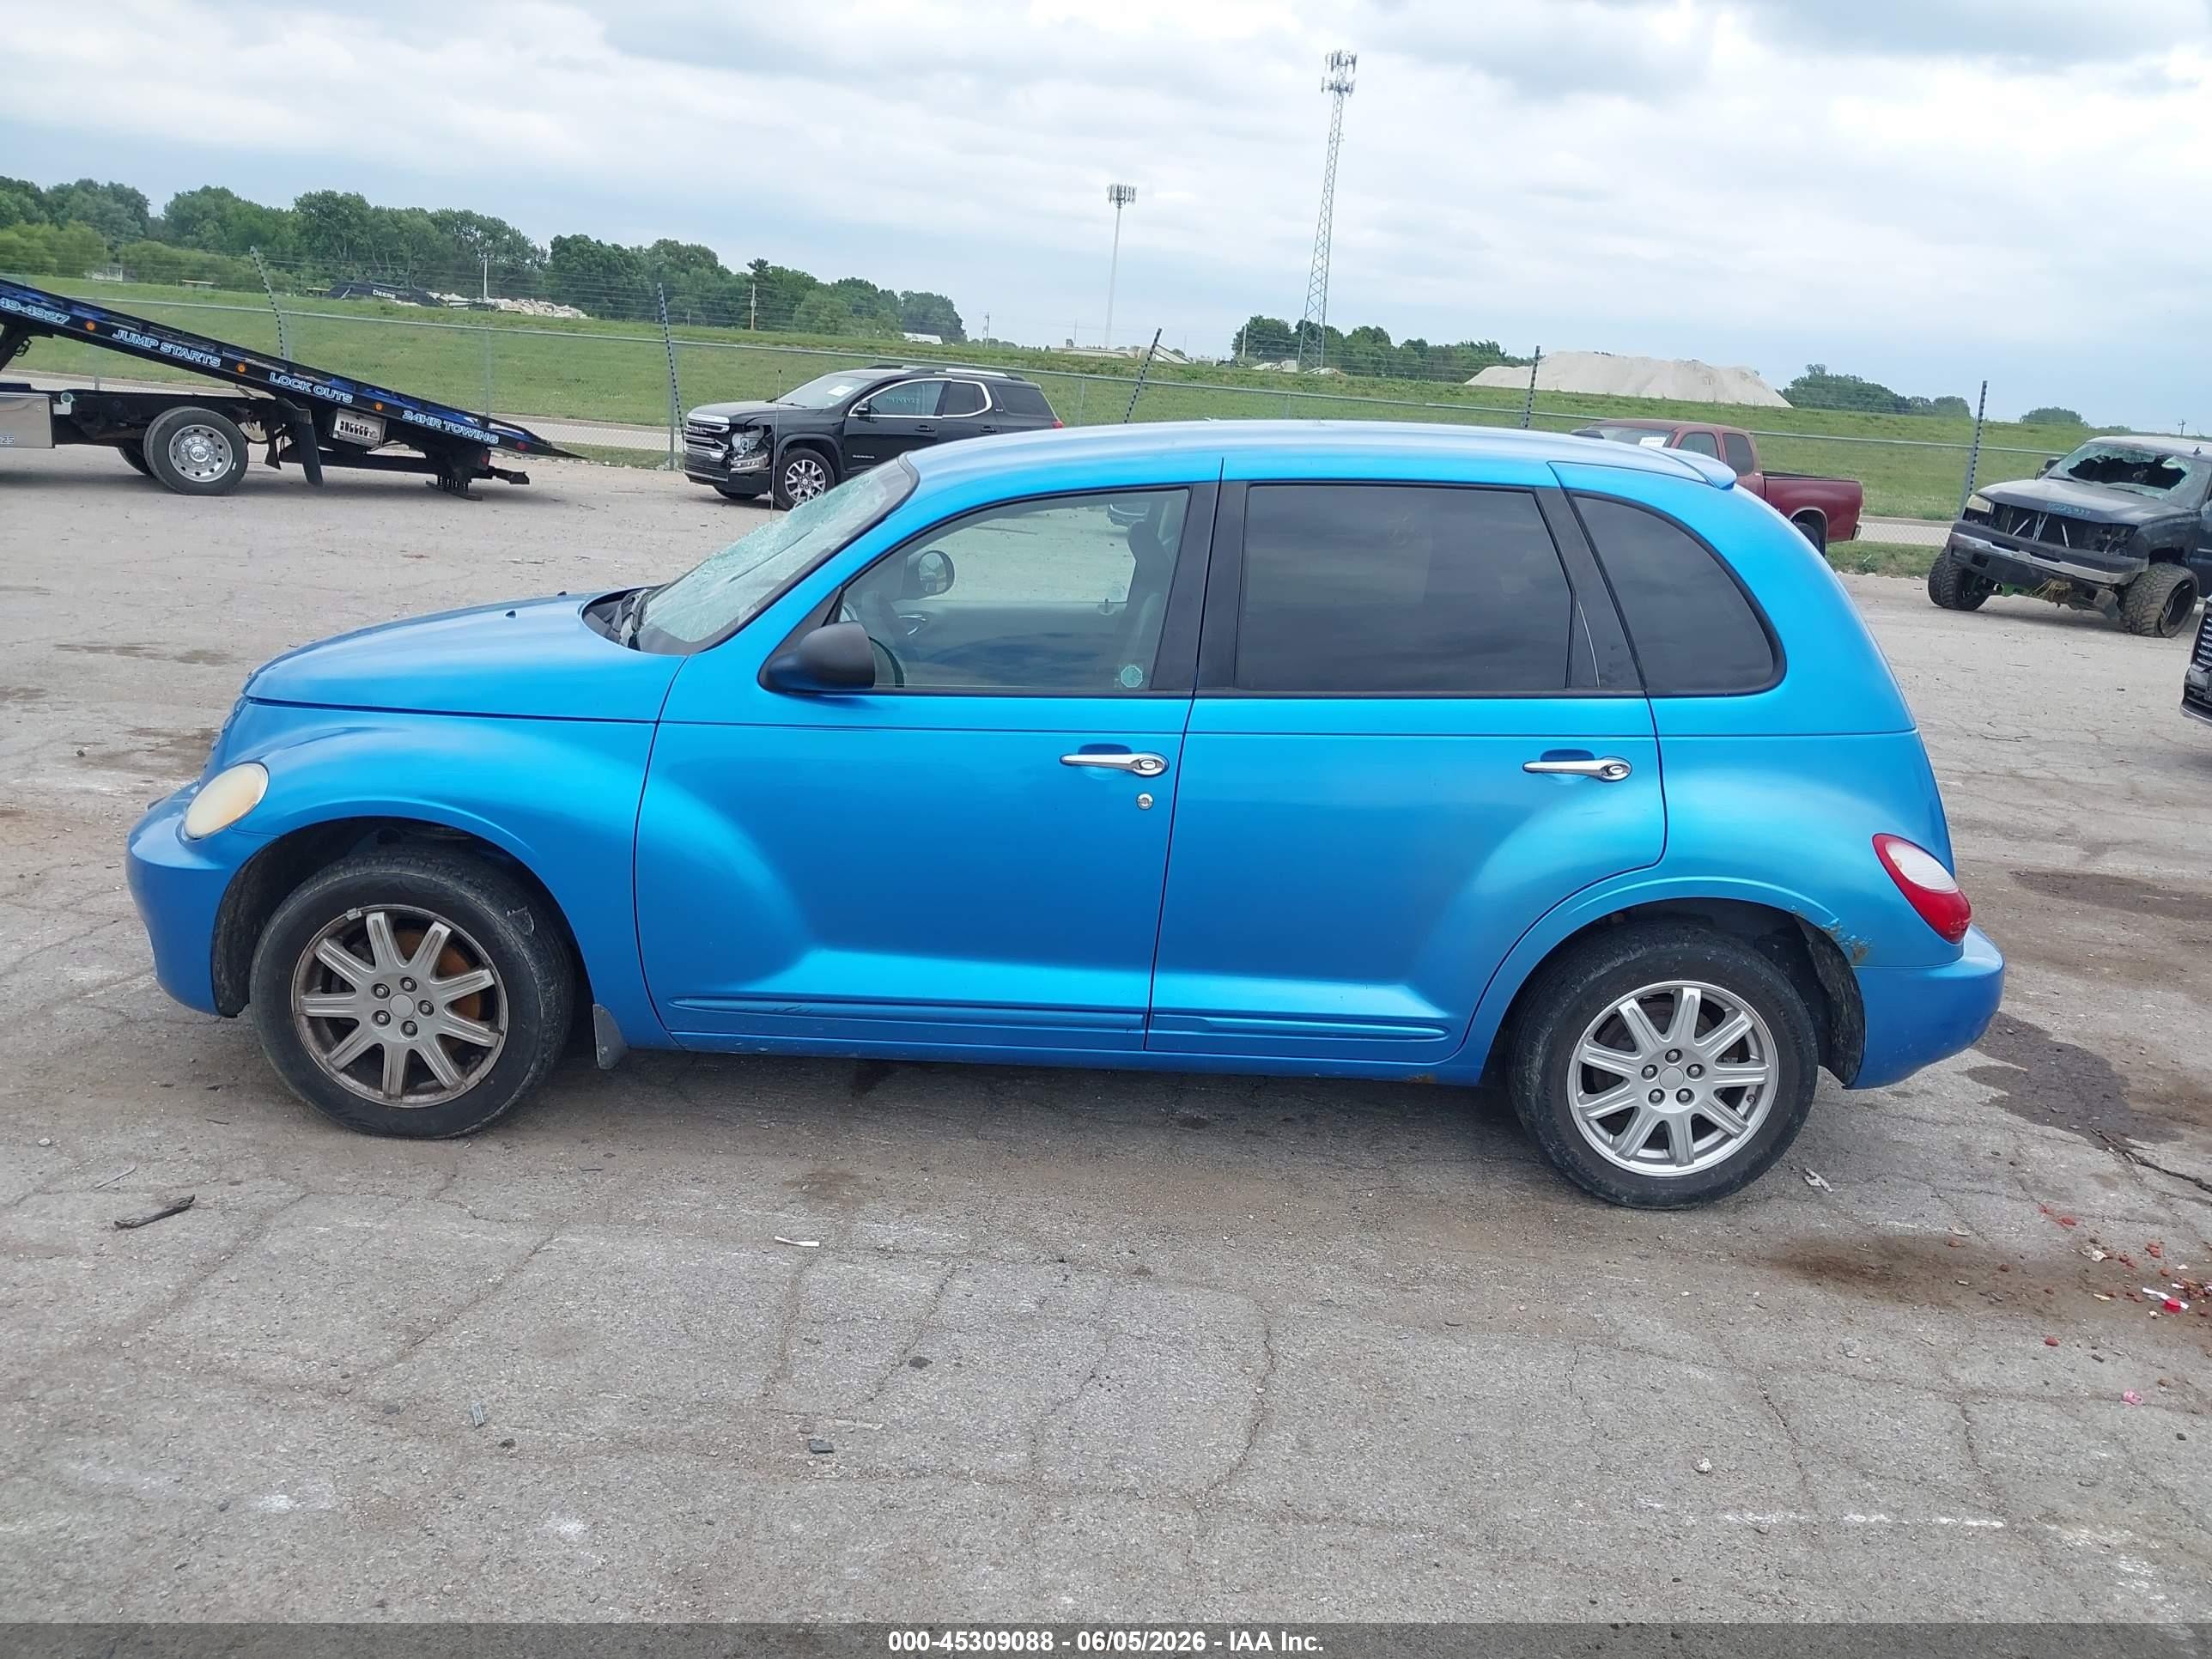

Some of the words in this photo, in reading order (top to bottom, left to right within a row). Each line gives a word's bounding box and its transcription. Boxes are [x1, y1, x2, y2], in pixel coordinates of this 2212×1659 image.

[373, 289, 397, 300] DEERE
[112, 329, 159, 349] JUMP
[160, 342, 222, 368] STARTS
[269, 372, 313, 392] LOCK
[313, 385, 354, 404] OUTS
[402, 410, 442, 428] 24HR
[443, 420, 500, 445] TOWING
